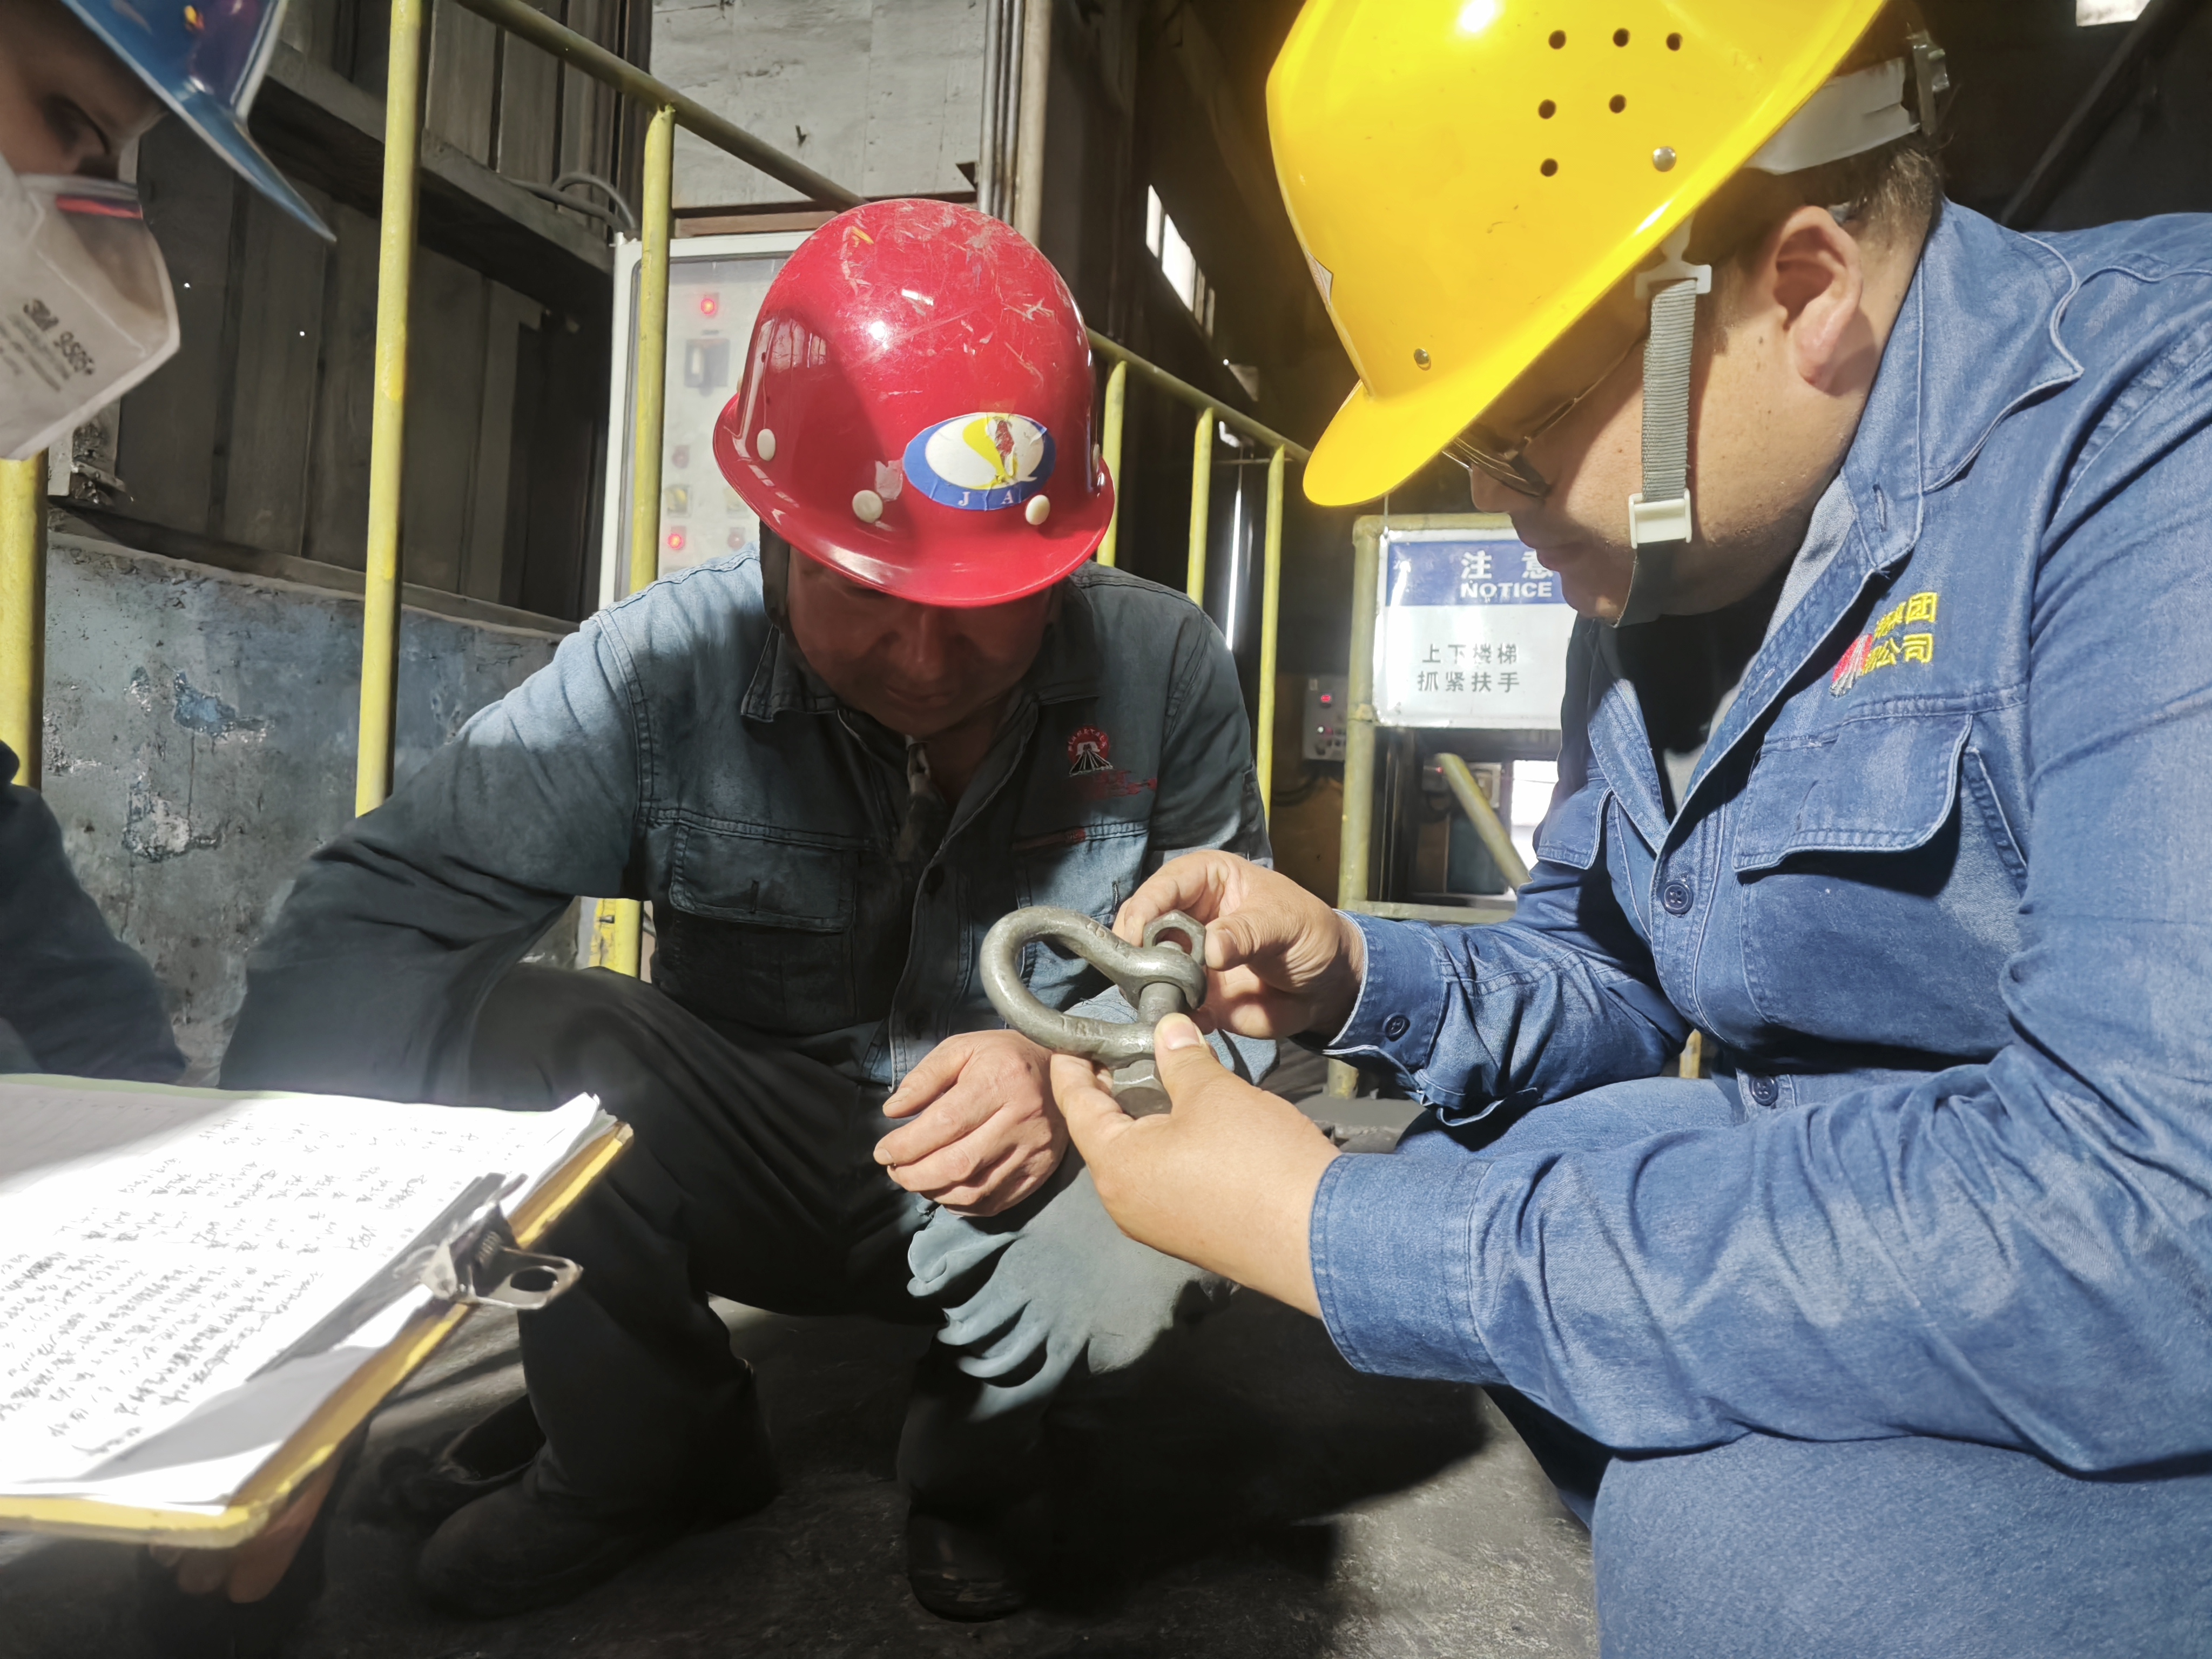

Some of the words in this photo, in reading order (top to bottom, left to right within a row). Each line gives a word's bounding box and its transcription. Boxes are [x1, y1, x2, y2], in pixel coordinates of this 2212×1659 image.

[1460, 582, 1553, 599] NOTICE
[1422, 643, 1518, 665] 上下楼梯
[1417, 670, 1520, 693] 抓紧扶手
